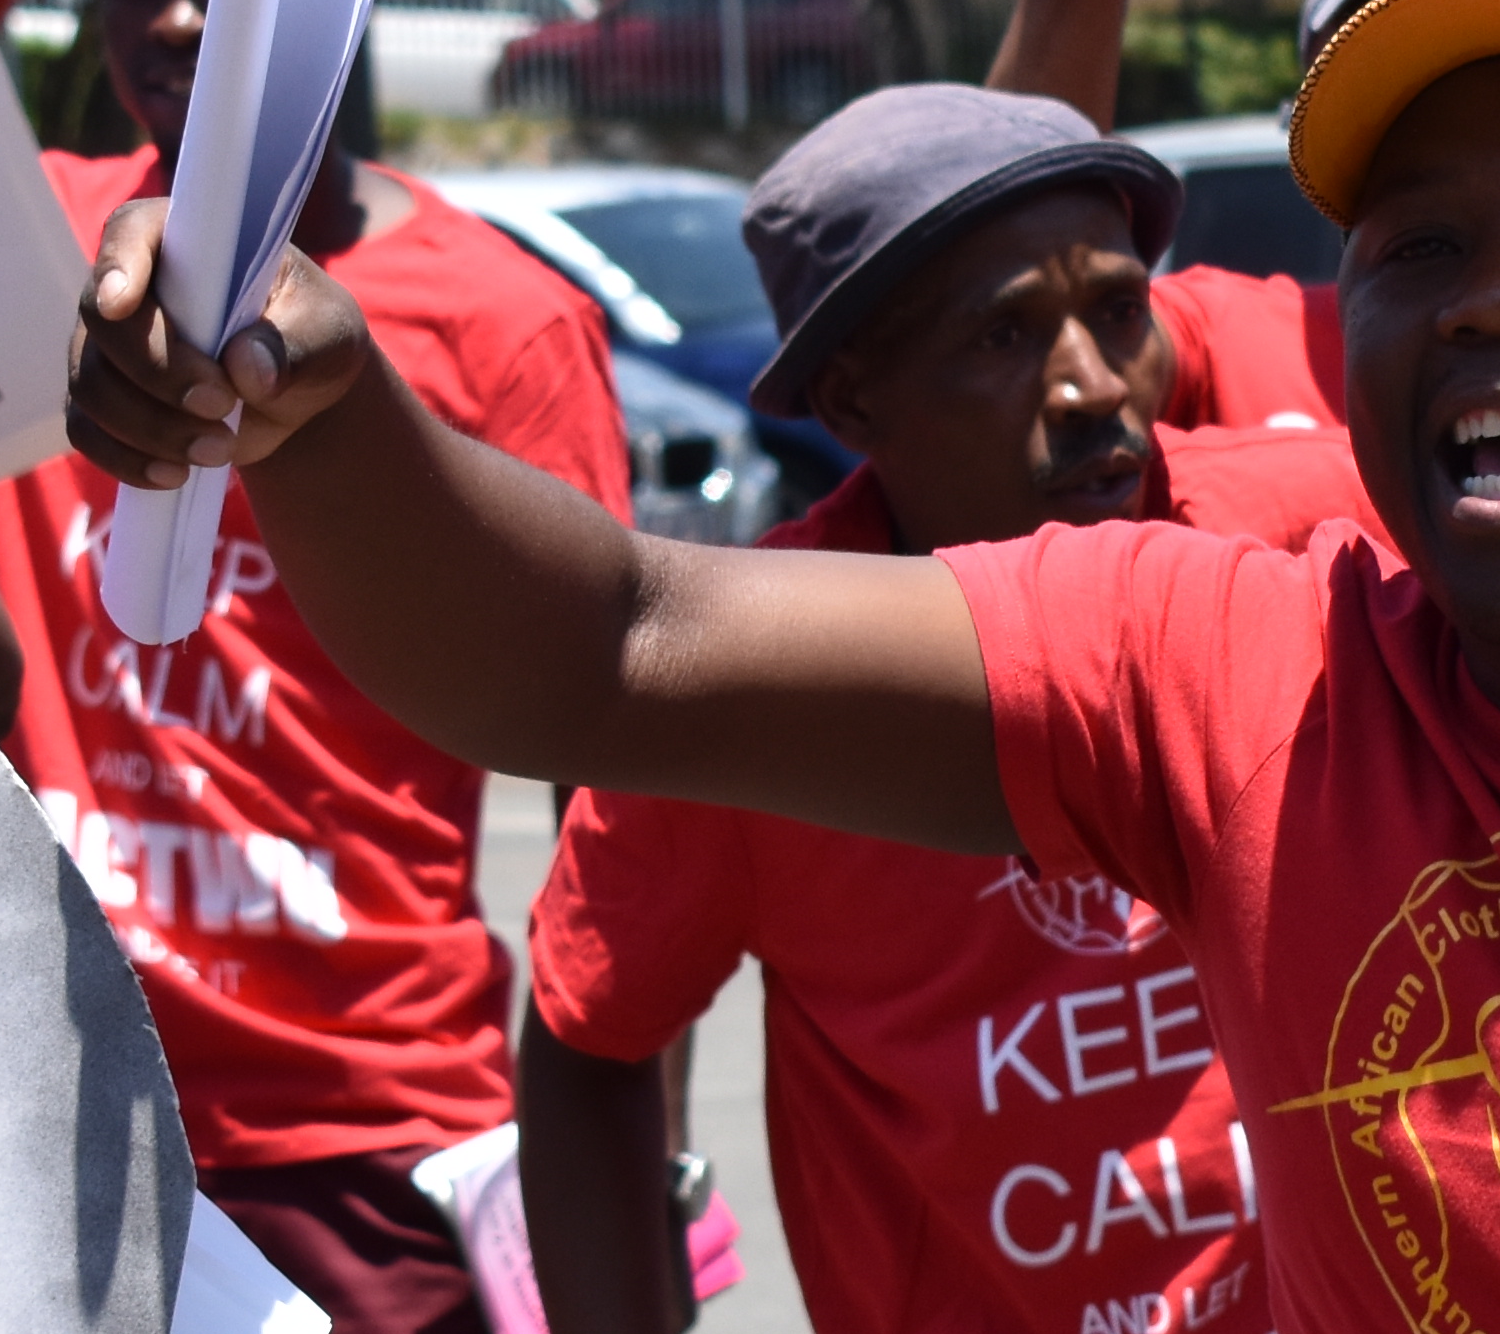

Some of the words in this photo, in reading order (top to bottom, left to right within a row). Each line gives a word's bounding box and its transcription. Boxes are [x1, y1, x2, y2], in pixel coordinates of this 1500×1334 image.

[65, 622, 273, 748] CALM
[976, 966, 1216, 1115] KEE
[1183, 1262, 1250, 1329] LET
